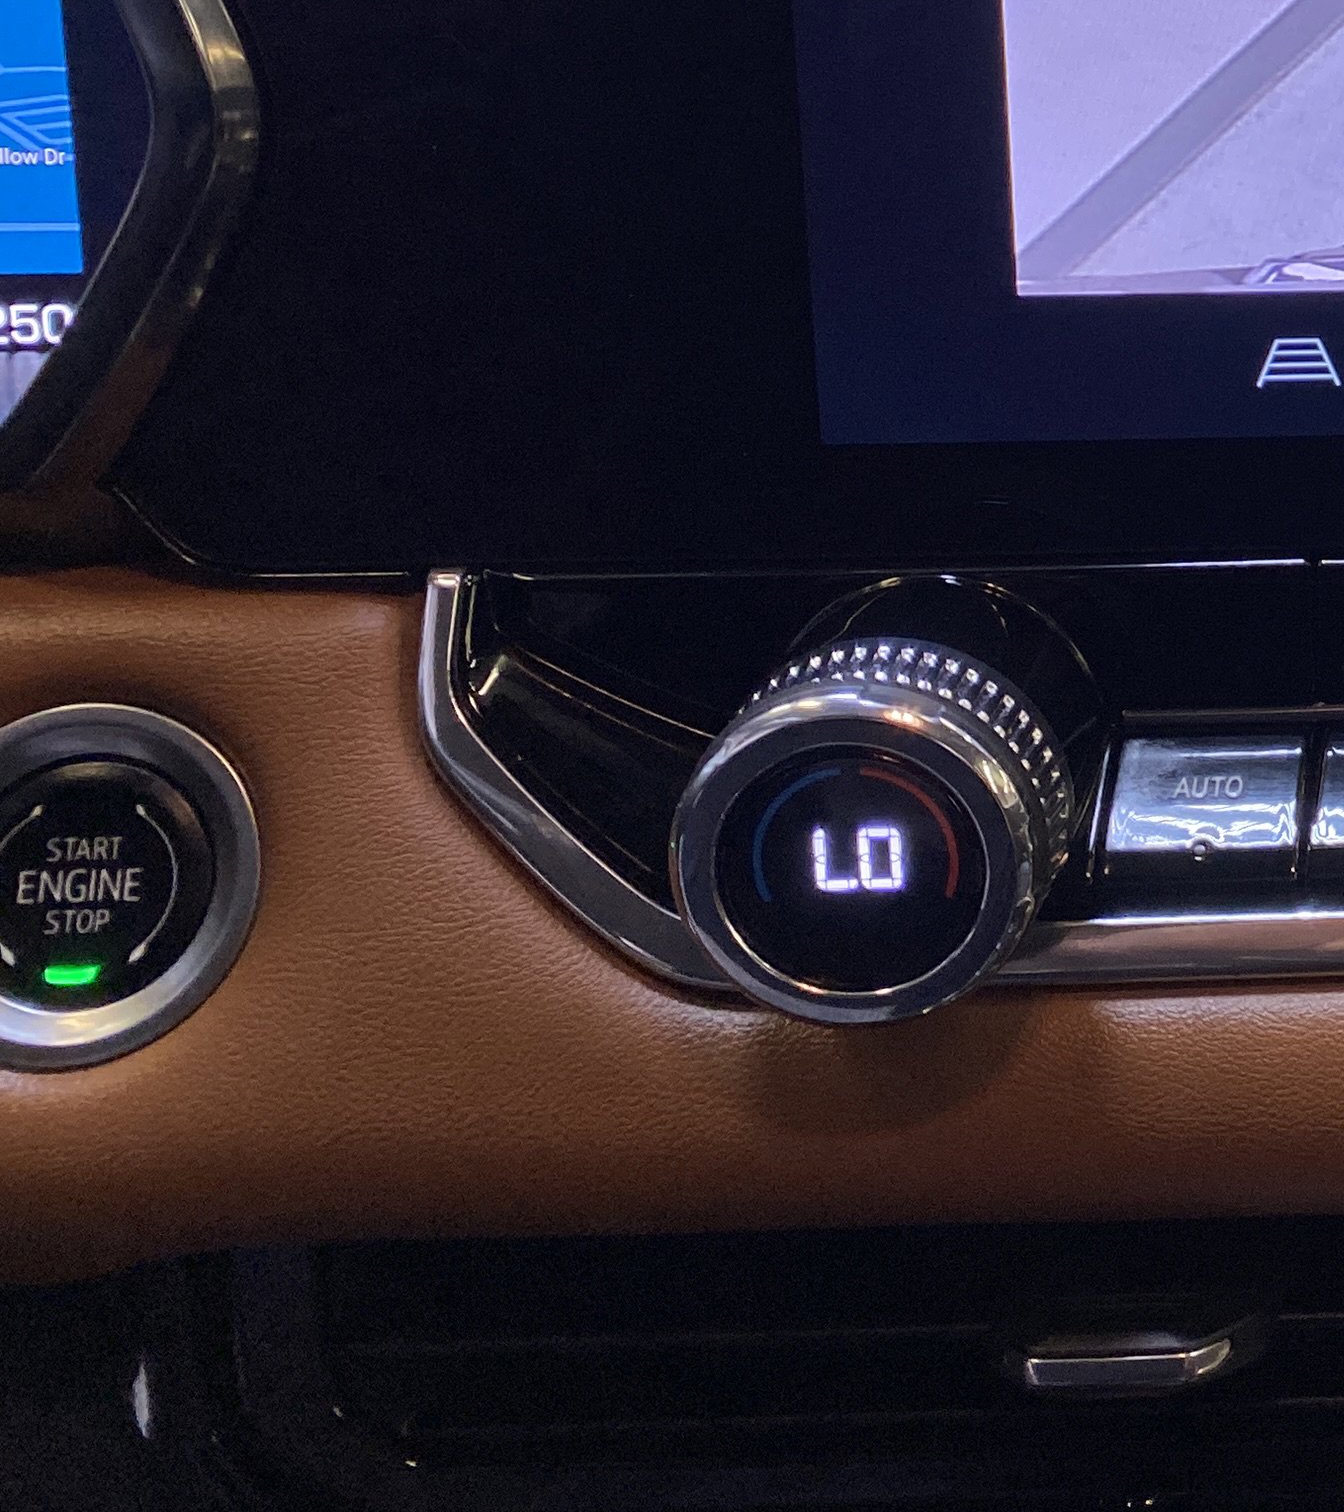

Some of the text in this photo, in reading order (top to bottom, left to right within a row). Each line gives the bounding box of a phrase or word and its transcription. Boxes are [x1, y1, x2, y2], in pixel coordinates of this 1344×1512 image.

[44, 147, 66, 166] Dr
[1173, 774, 1244, 801] AUTO
[46, 836, 123, 864] START
[16, 867, 145, 905] ENGINE
[42, 908, 112, 936] STOP
